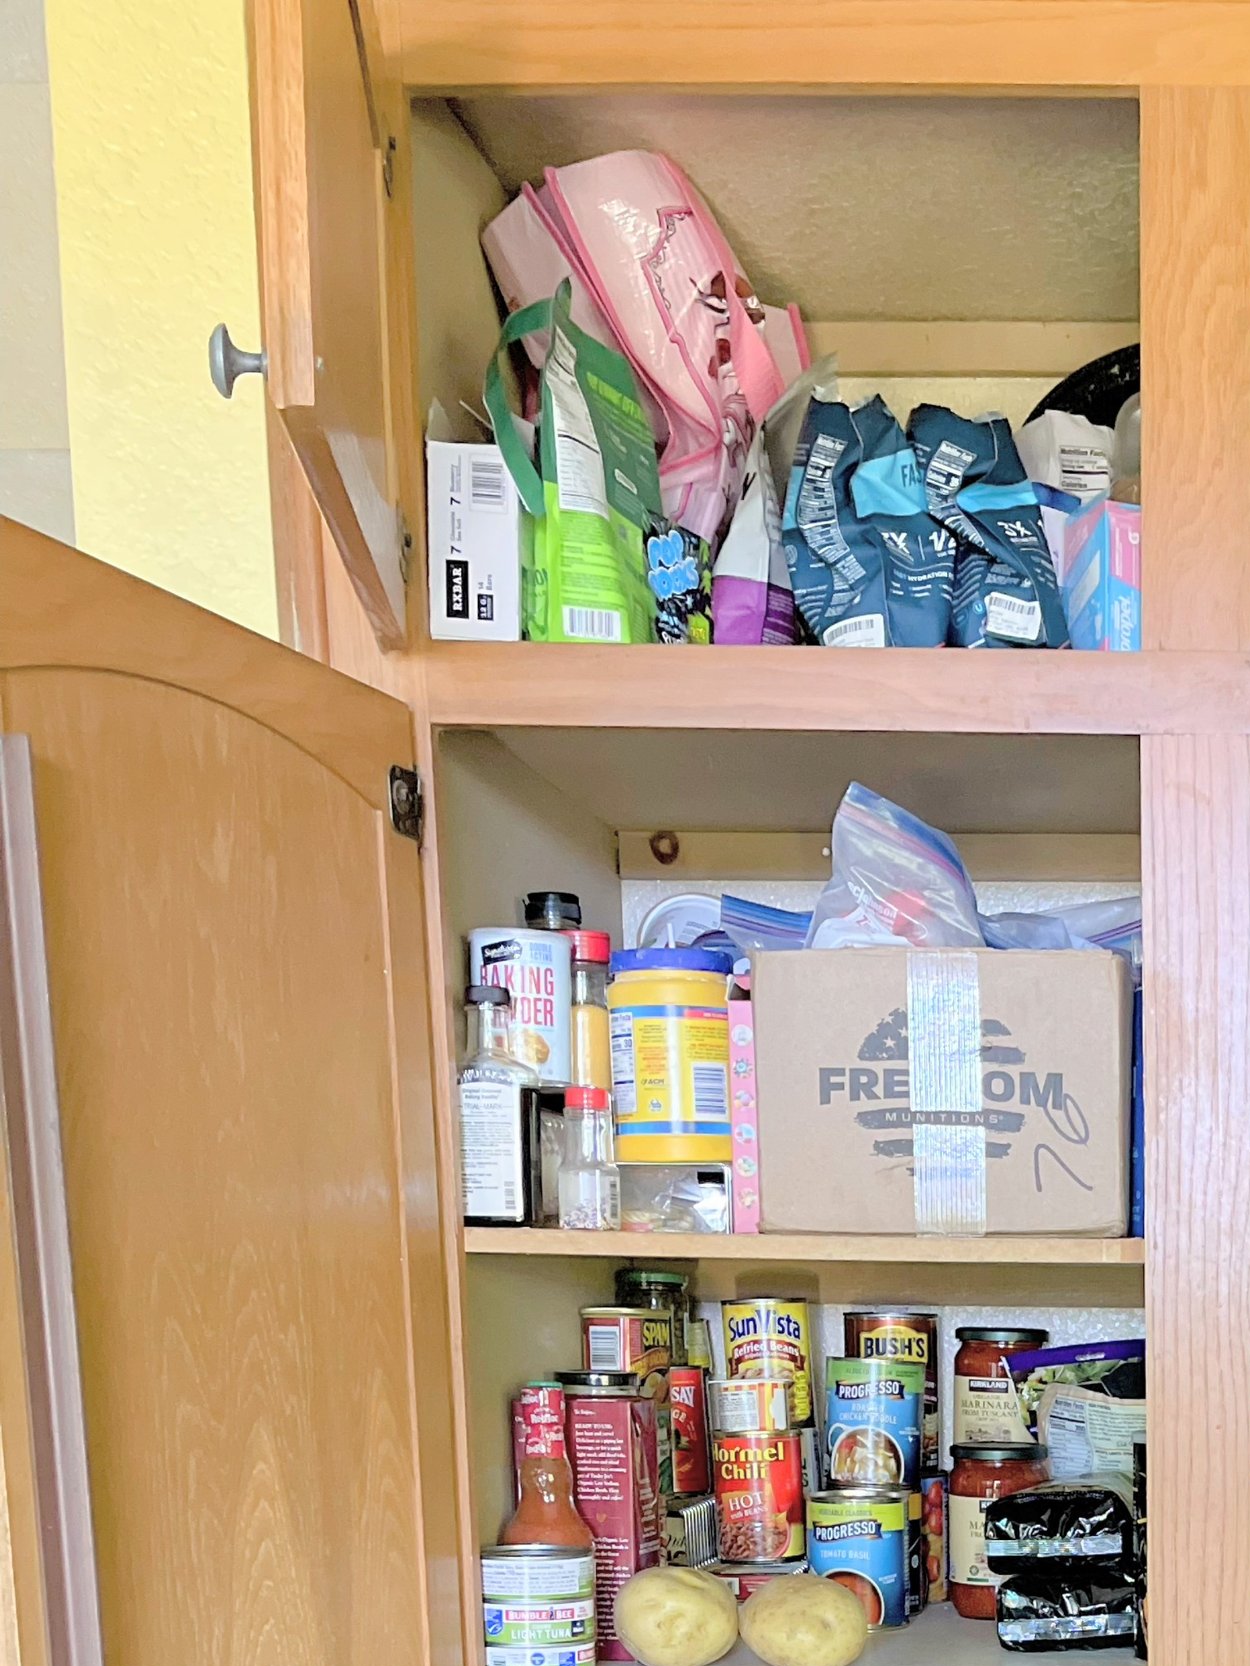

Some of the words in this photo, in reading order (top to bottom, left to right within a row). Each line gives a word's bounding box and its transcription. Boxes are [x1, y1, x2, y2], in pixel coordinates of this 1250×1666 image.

[450, 497, 461, 505] 7
[450, 545, 461, 554] 7
[452, 567, 463, 611] RXBAR
[480, 965, 554, 996] BAKING
[497, 997, 554, 1027] WDER
[819, 1067, 1063, 1110] FREOM
[885, 1112, 998, 1123] MUNITIONS
[643, 1322, 669, 1346] SPAM
[728, 1310, 801, 1342] SunVista
[734, 1342, 765, 1358] Refried
[770, 1342, 799, 1356] Beans
[864, 1337, 925, 1358] BUSH'S
[838, 1381, 900, 1399] PROGRESSO
[970, 1380, 1008, 1389] KIRKLAND
[671, 1387, 695, 1407] SAY
[961, 1400, 1018, 1410] MARINARA
[839, 1412, 866, 1422] CHICKEN
[721, 1463, 768, 1480] Chili
[729, 1492, 764, 1511] HOT
[816, 1521, 876, 1541] PROGRESSO
[821, 1550, 846, 1559] TOMATO
[849, 1551, 869, 1560] BASIL
[508, 1610, 547, 1620] BUMBLE
[556, 1609, 573, 1618] BEE
[511, 1629, 544, 1640] LIGHT
[545, 1627, 572, 1639] TUNA
